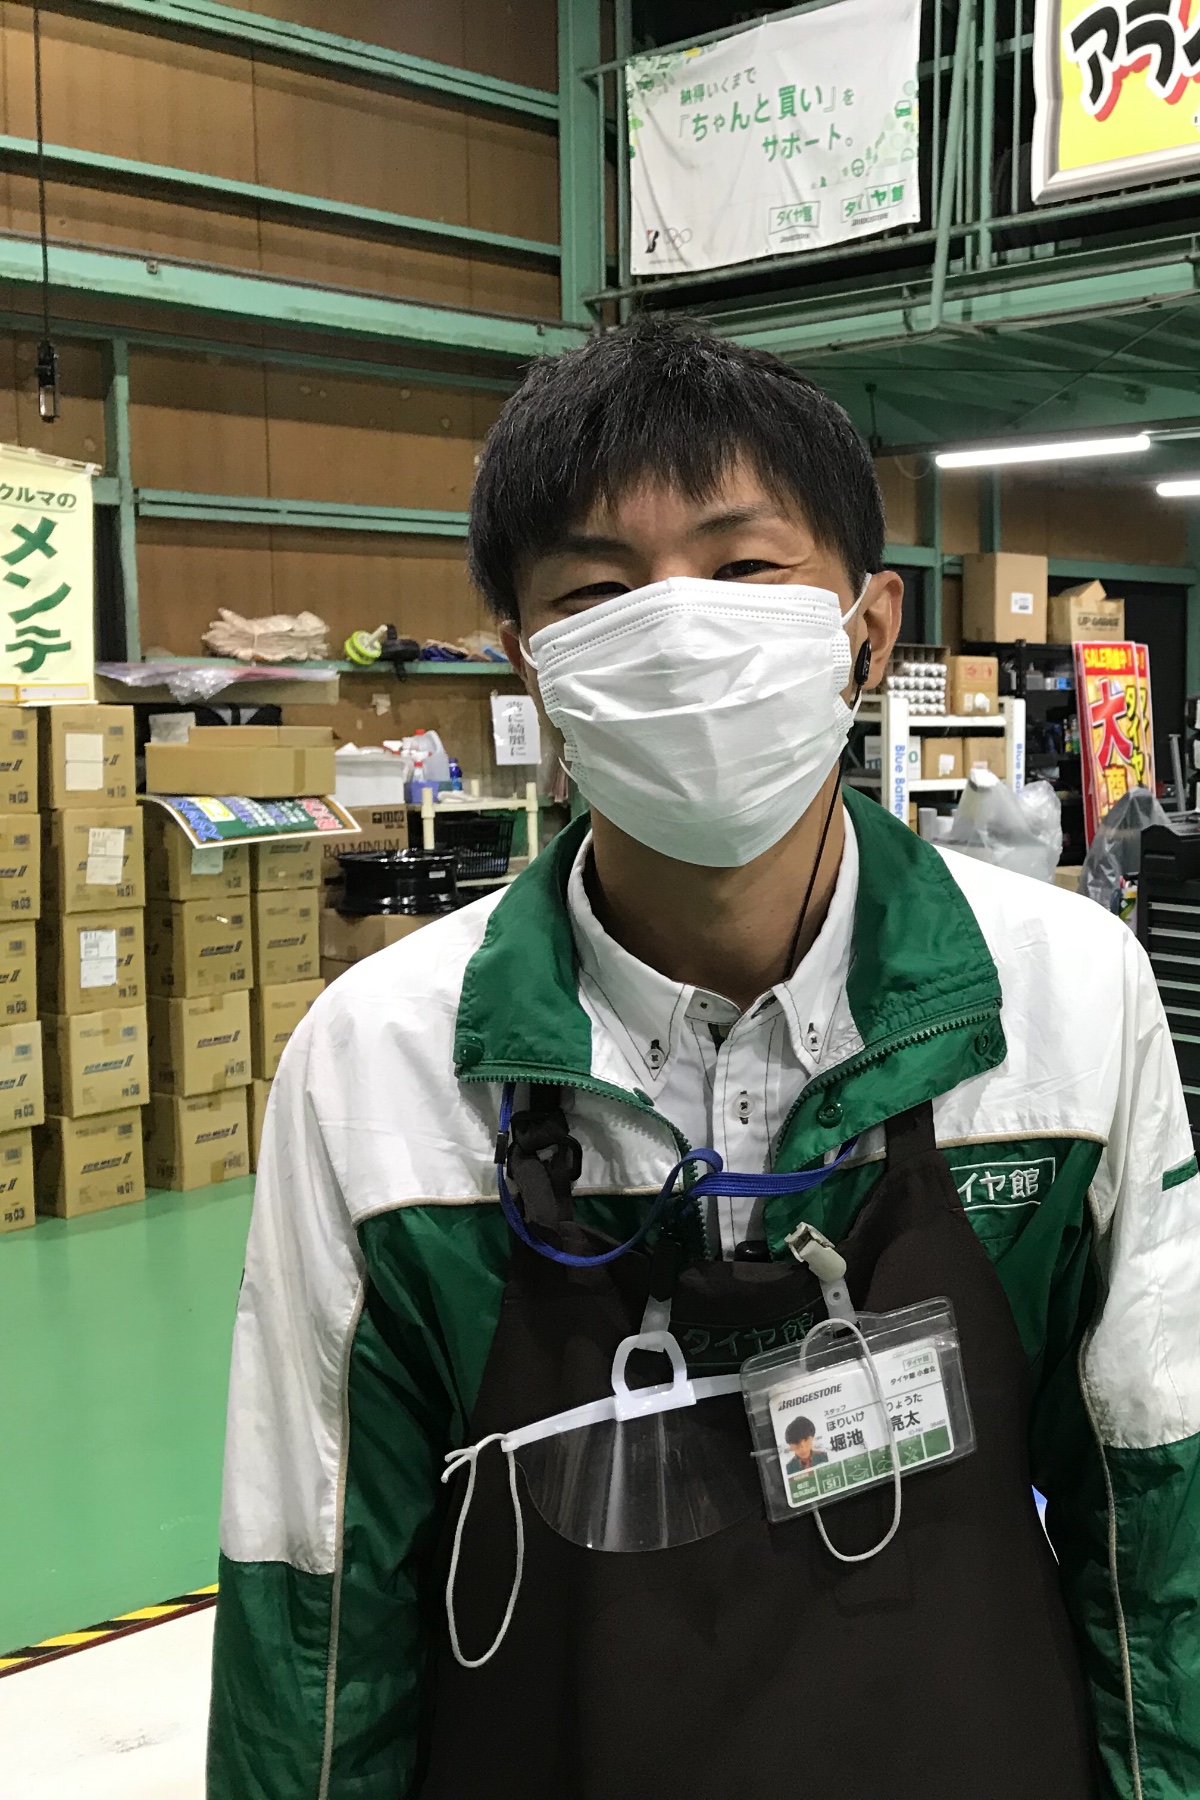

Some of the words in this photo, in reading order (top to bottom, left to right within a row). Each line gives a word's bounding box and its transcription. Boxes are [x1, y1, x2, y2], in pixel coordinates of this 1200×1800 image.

[680, 67, 756, 106] 納得いくまで
[679, 84, 854, 143] 『ちゃんと買い』を
[762, 123, 854, 162] サポート。
[0, 483, 77, 509] クルマの
[1, 516, 72, 674] メンテ
[895, 745, 906, 773] Blue
[683, 1311, 814, 1356] タイヤ館
[778, 1383, 843, 1412] BRIDGESTONE
[823, 1404, 847, 1417] スタッフ
[826, 1410, 865, 1432] ほりいけ
[829, 1427, 865, 1453] 堀池
[890, 1409, 921, 1432] 亮太
